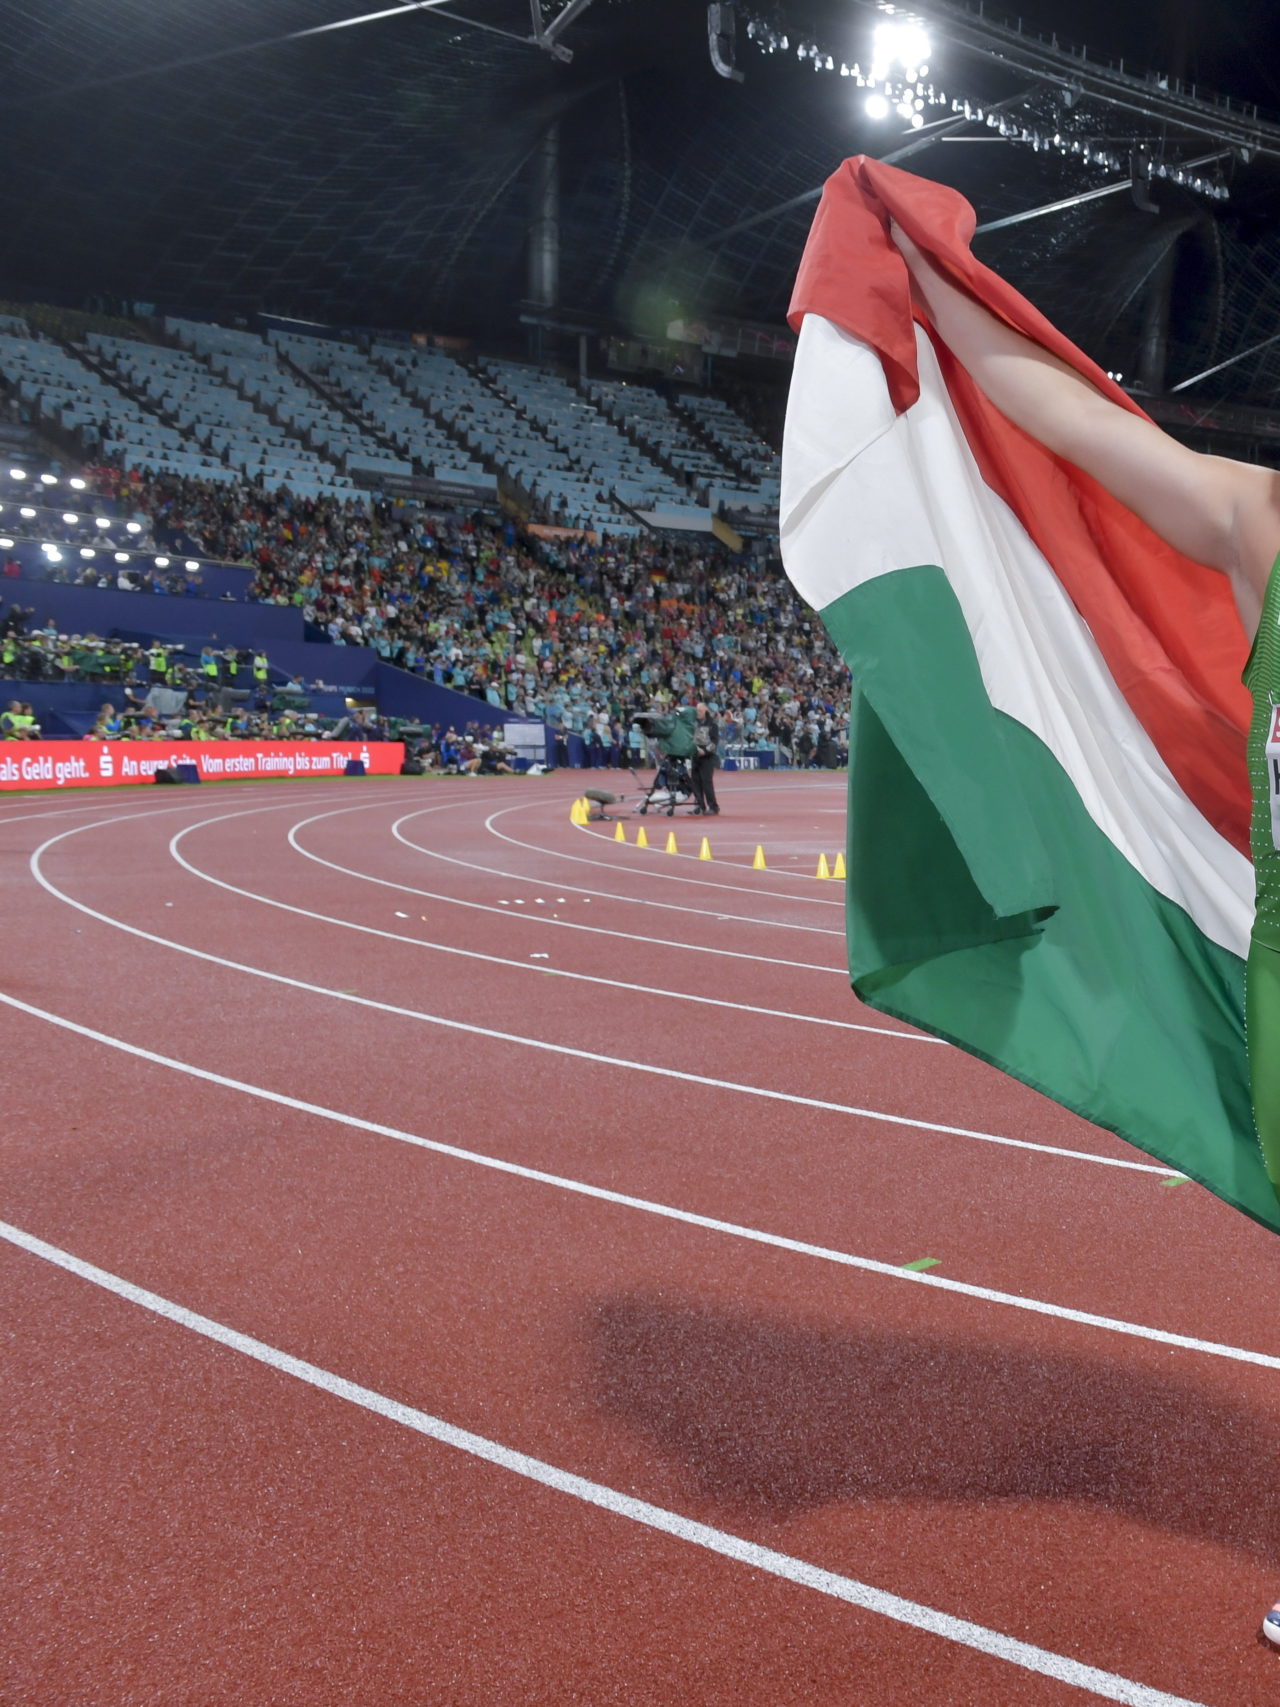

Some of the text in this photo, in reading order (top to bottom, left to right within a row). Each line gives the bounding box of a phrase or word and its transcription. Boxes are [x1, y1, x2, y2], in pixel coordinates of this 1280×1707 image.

[0, 755, 90, 785] als Geld geht.
[122, 756, 138, 776] An
[201, 754, 223, 773] Vom
[225, 755, 255, 772] ersten
[256, 752, 294, 775] Training
[295, 752, 310, 770] bis
[311, 756, 331, 770] zum
